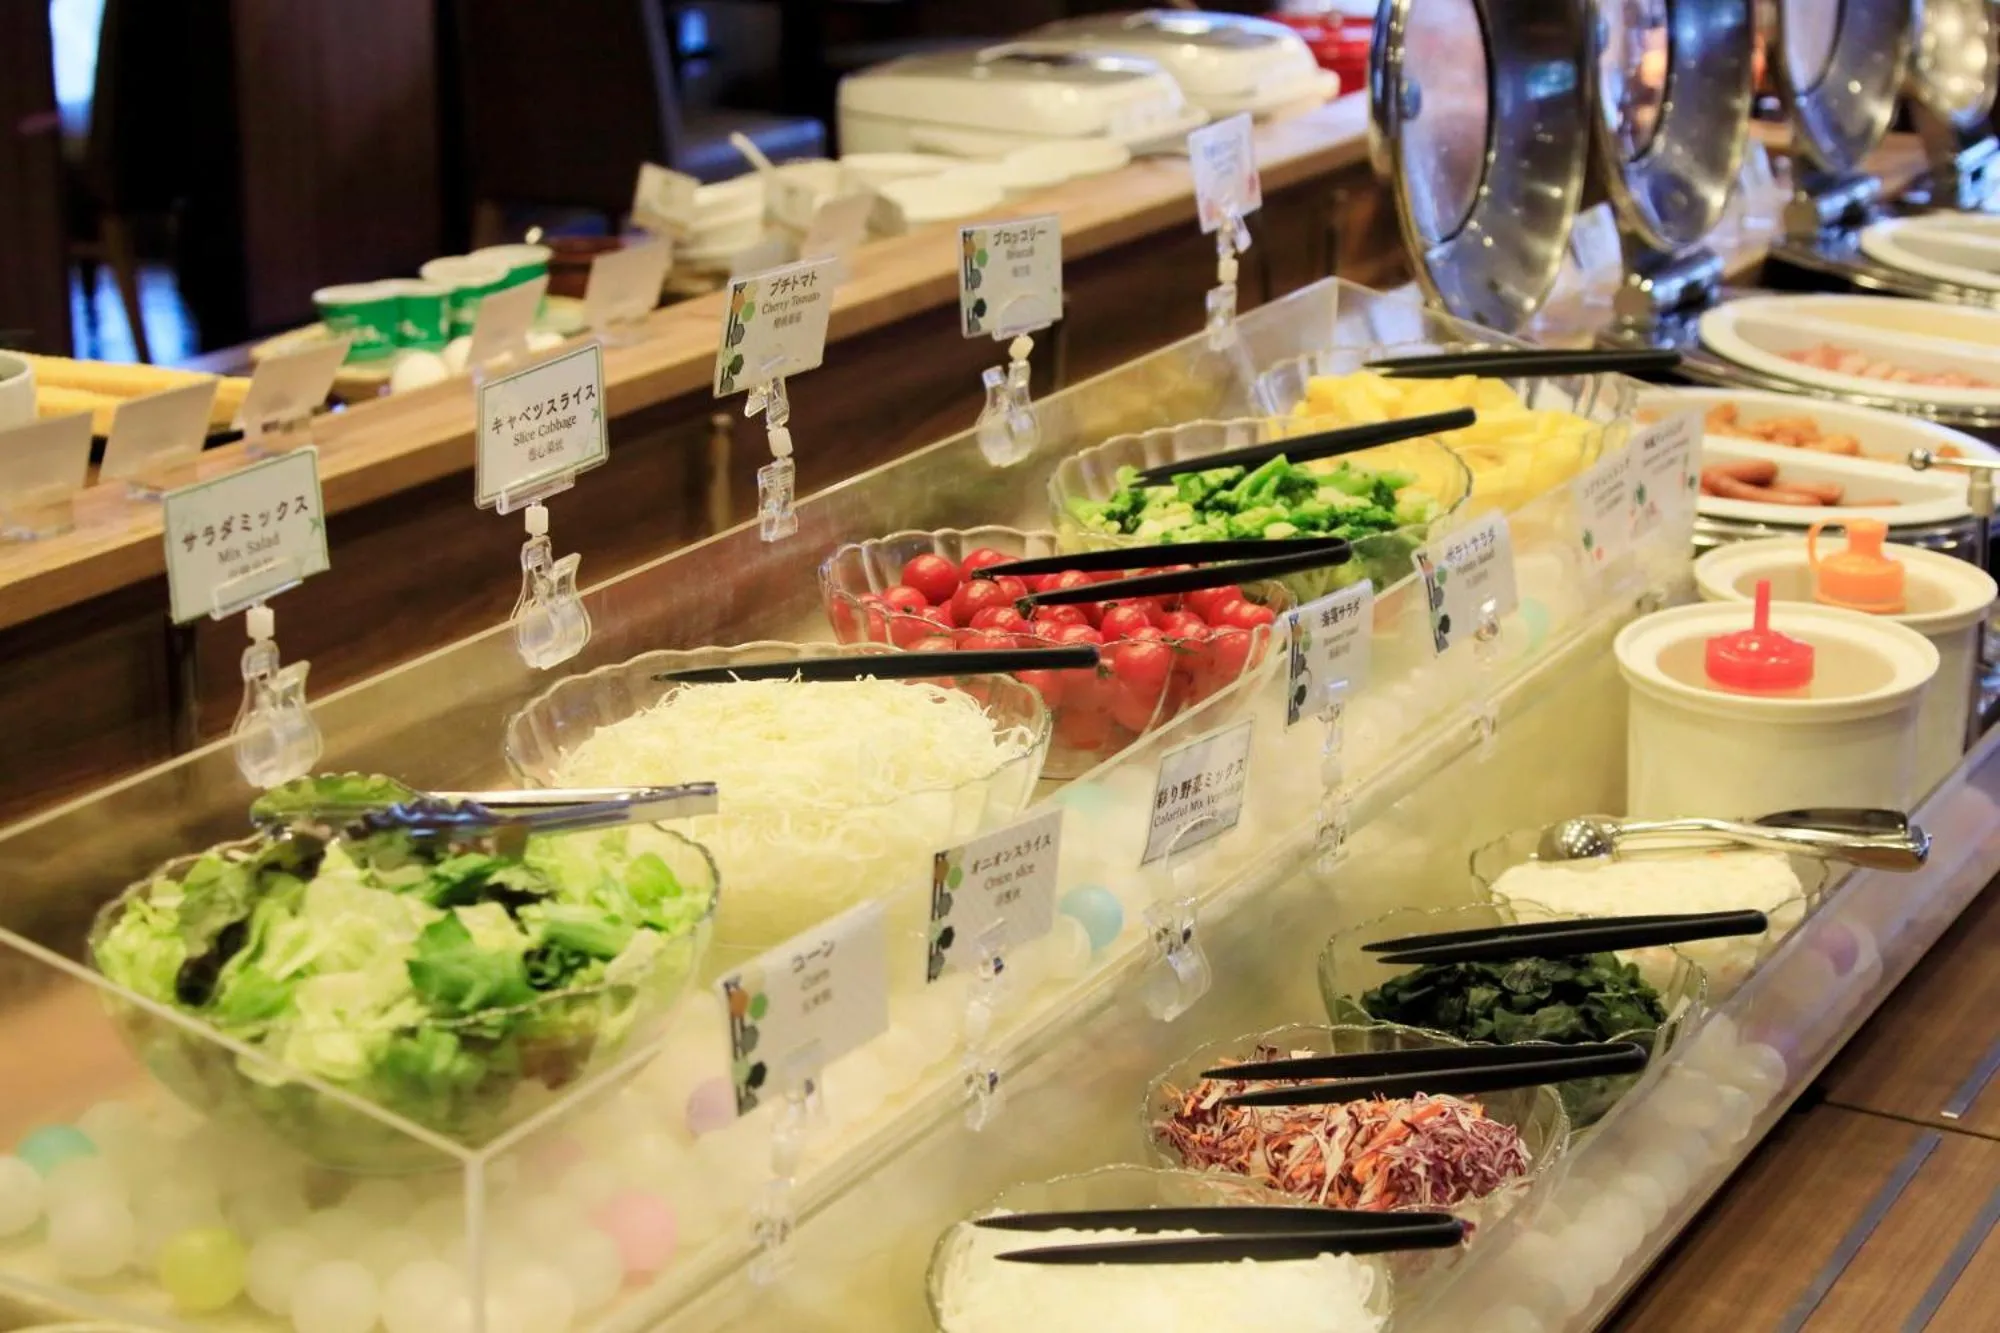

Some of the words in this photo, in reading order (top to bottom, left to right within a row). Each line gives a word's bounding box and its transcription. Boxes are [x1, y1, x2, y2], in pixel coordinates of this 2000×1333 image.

[993, 226, 1047, 247] ブロッコリー
[762, 299, 790, 315] Cherry
[491, 383, 596, 435] キャベツスライス
[512, 429, 536, 447] Slice
[538, 415, 577, 437] Cabbage
[181, 494, 309, 553] サラダミックス
[217, 549, 241, 563] Mix
[245, 532, 280, 552] Salad
[1156, 758, 1245, 810] 彩り野菜ミックス
[1154, 803, 1189, 828] Colorful
[970, 833, 1052, 875] オニオンスライス
[791, 939, 835, 974] コーン
